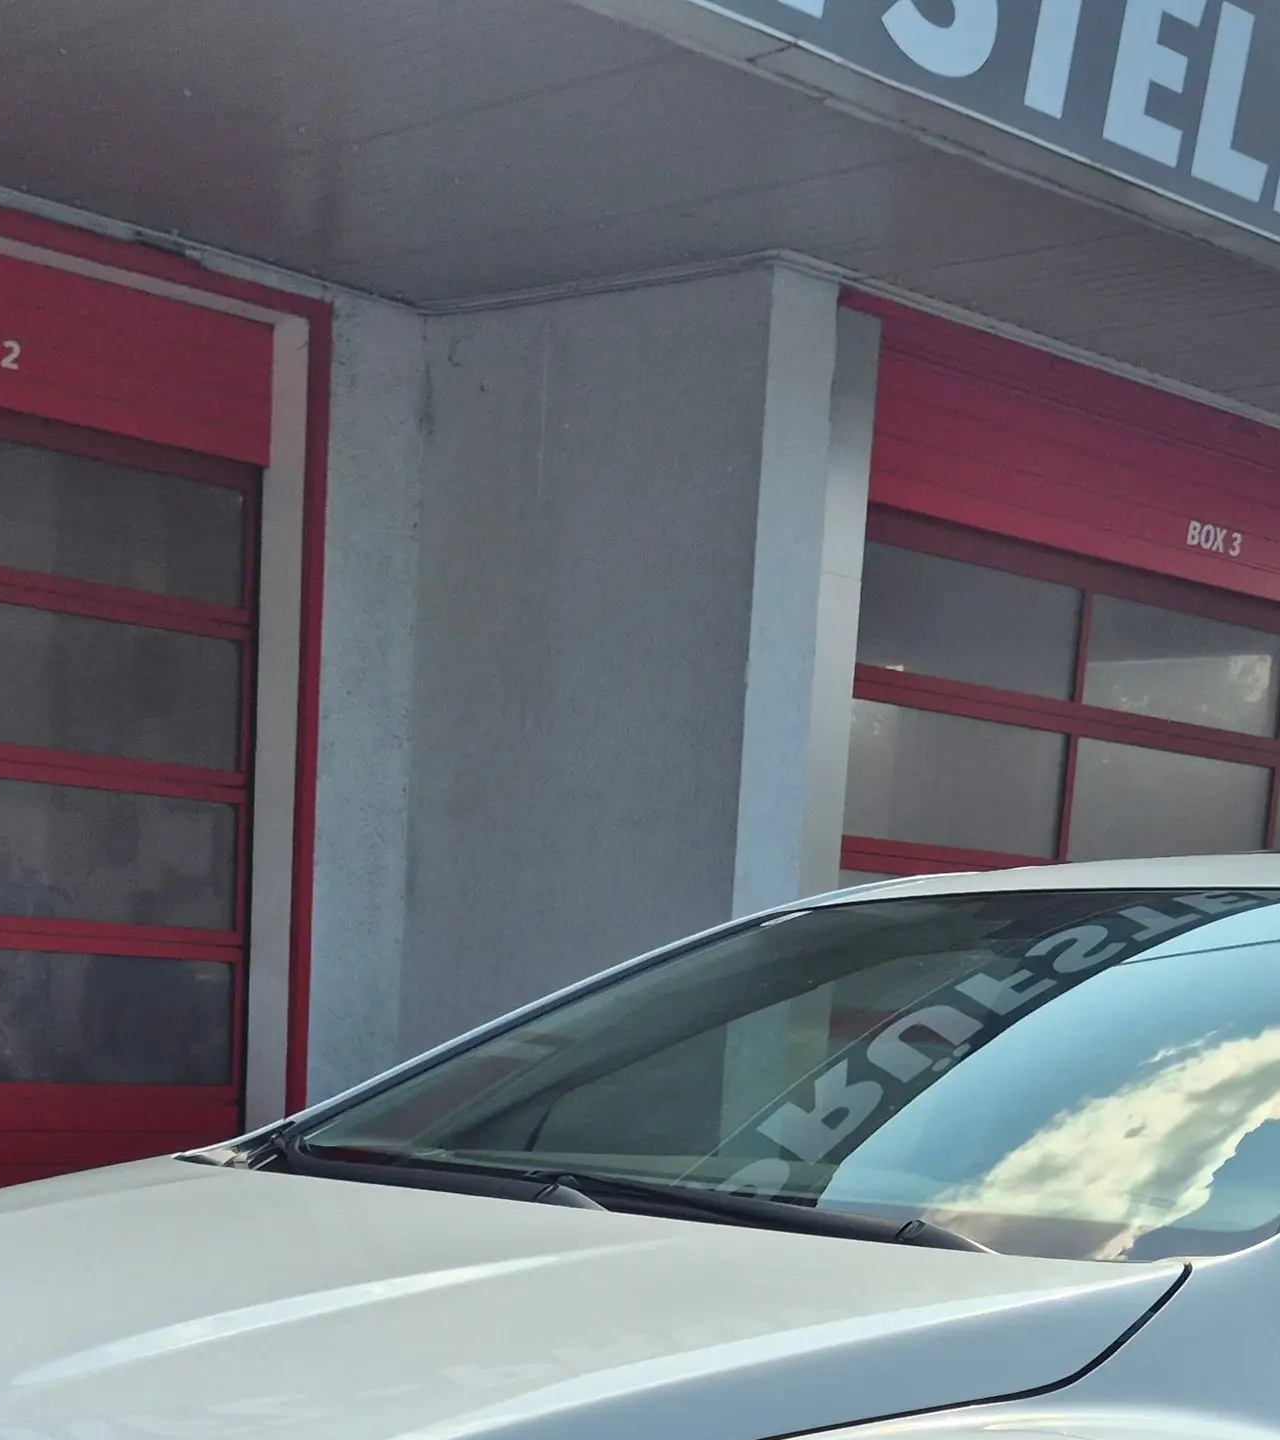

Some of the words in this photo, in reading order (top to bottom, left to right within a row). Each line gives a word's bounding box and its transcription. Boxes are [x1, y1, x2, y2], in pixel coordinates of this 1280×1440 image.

[0, 340, 22, 370] 2
[1186, 519, 1228, 553] BOX
[1228, 532, 1242, 557] 3
